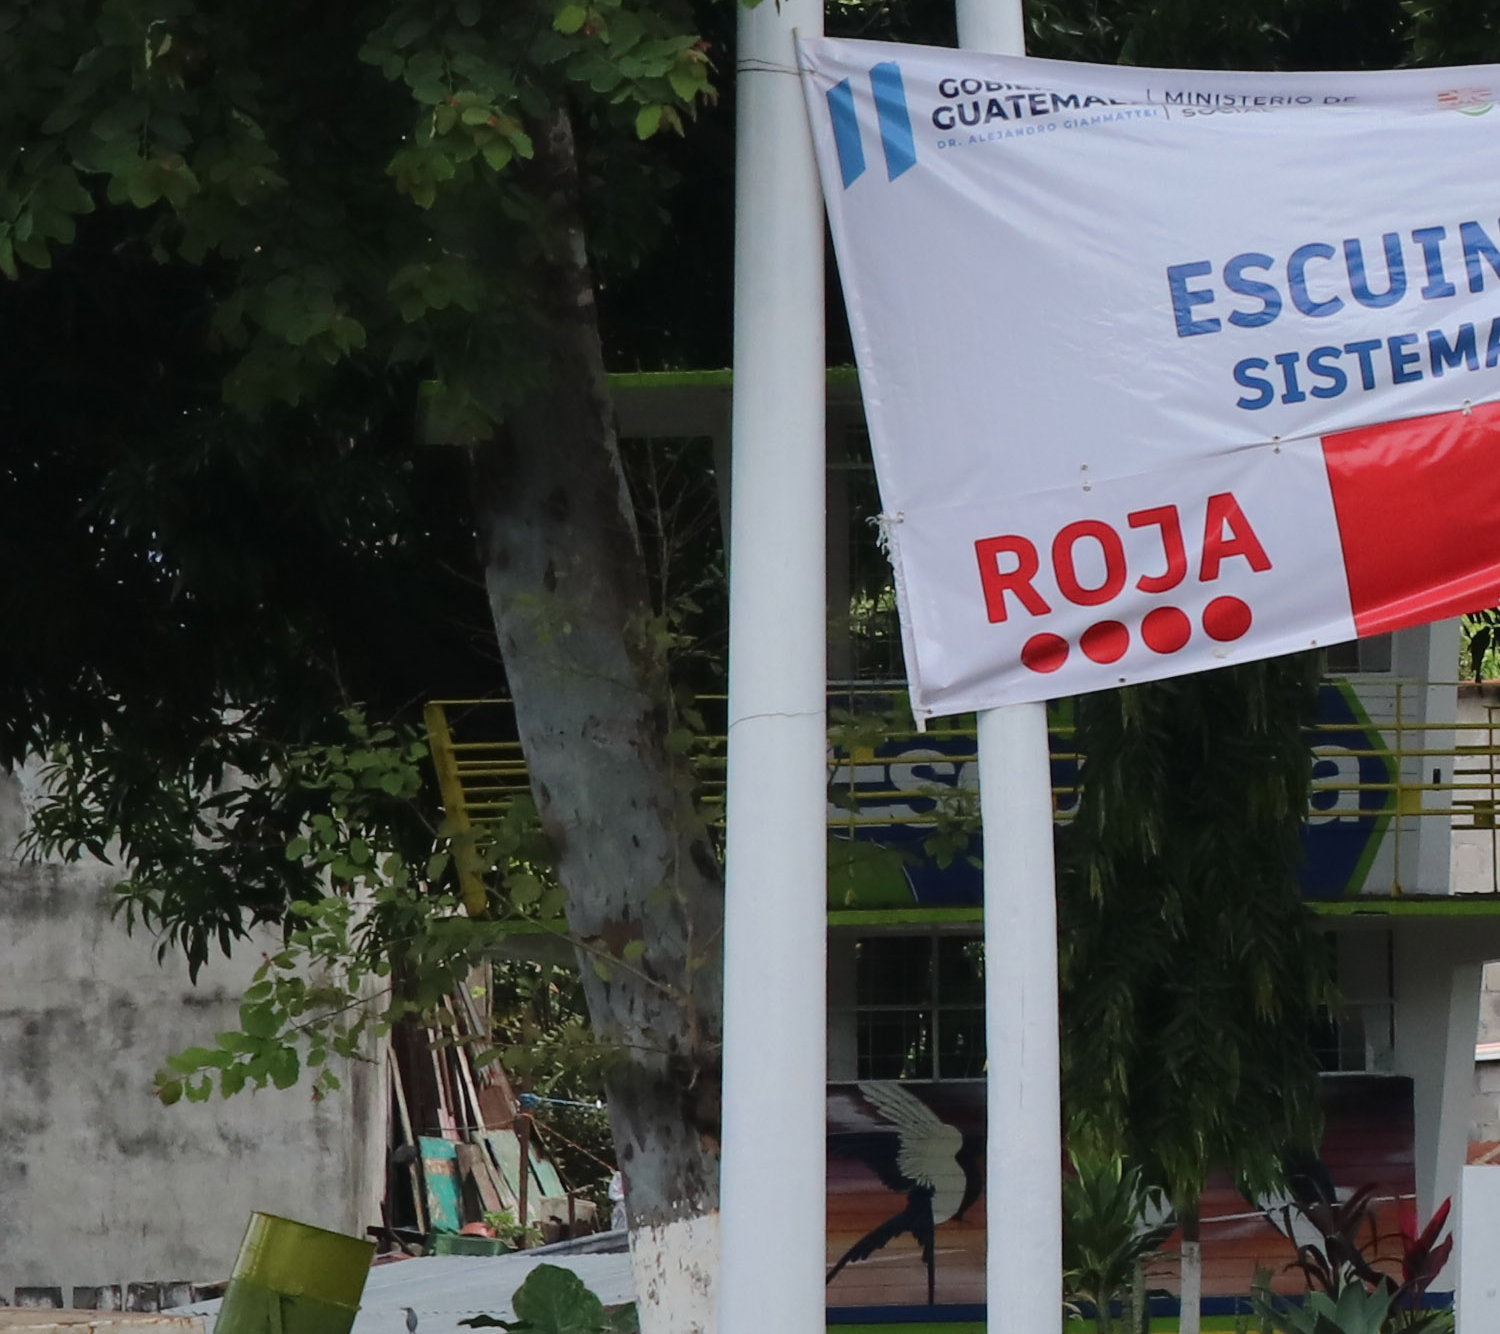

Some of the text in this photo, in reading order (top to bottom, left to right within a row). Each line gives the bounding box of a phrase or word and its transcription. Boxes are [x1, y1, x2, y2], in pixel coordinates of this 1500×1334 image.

[1165, 91, 1313, 107] MINISTERIO
[937, 108, 1159, 150] DR. ALEJANDRO GIAMMATTEI
[974, 491, 1273, 625] ROJA
